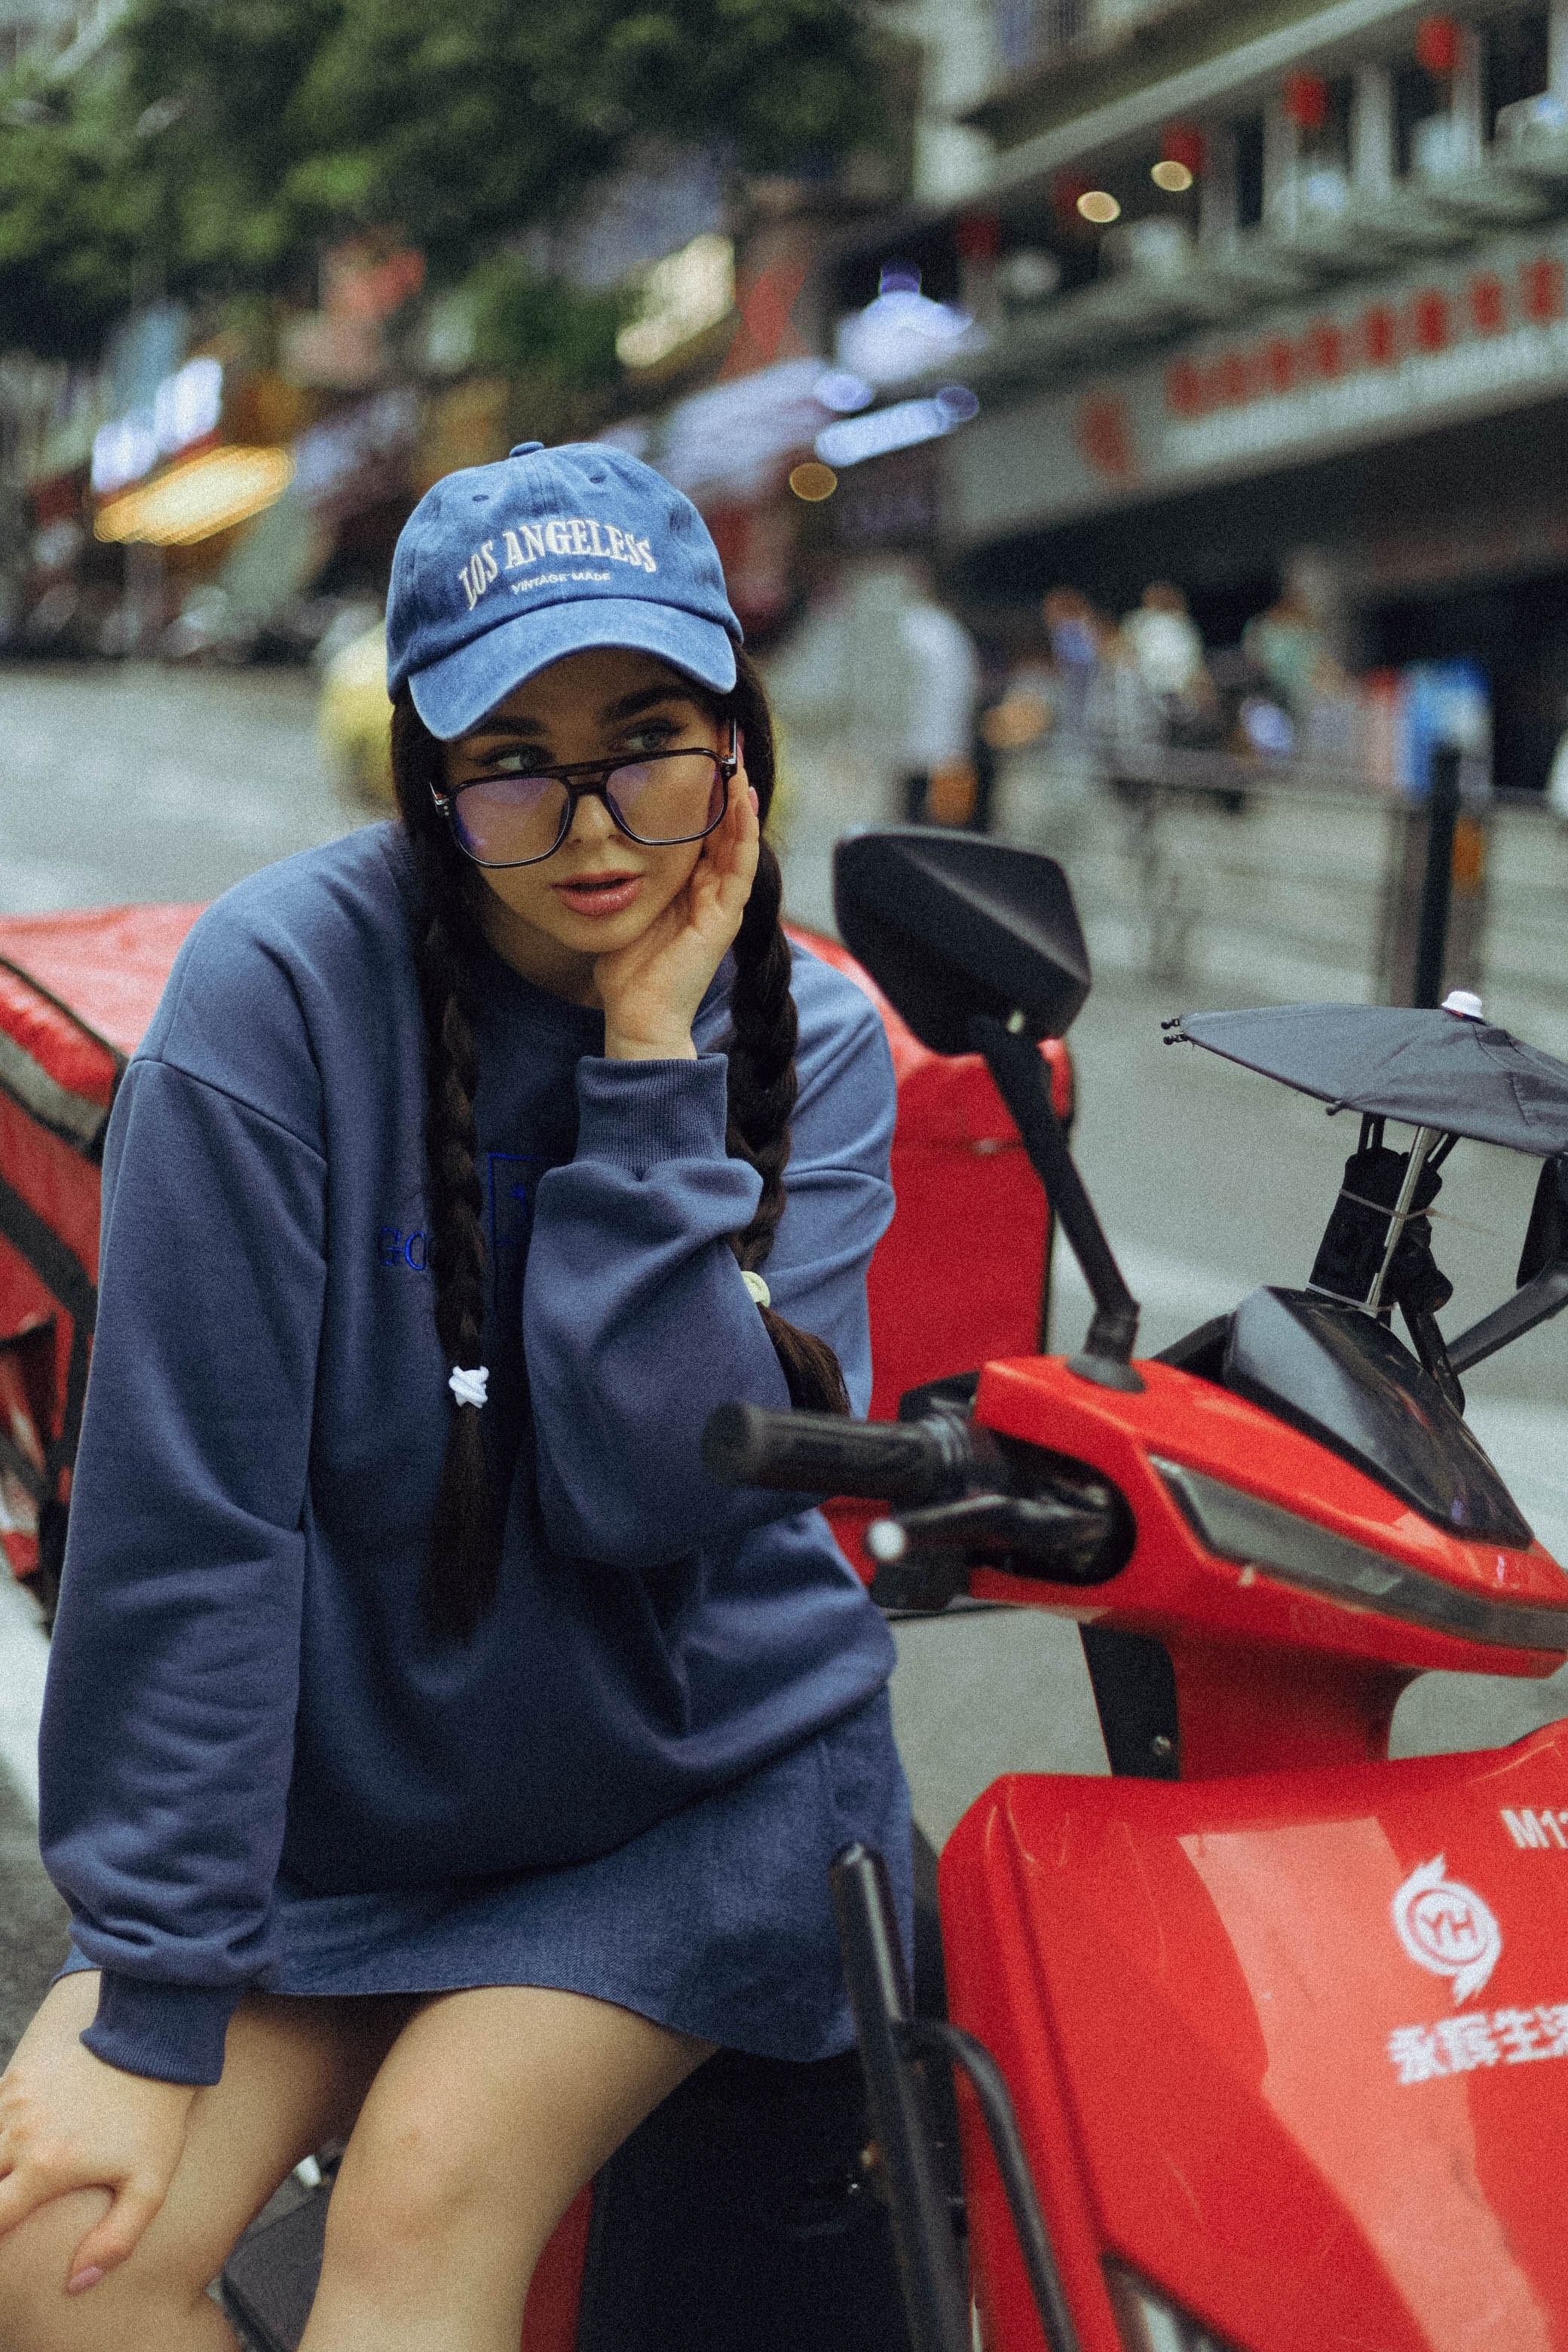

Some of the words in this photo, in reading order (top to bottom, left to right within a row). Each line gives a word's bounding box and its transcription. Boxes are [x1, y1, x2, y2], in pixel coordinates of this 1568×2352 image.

[458, 539, 498, 611] LOS
[502, 518, 658, 573] ANGELESS
[511, 574, 568, 596] VINTAGE
[571, 571, 611, 581] MADE
[1420, 1908, 1478, 1947] YH
